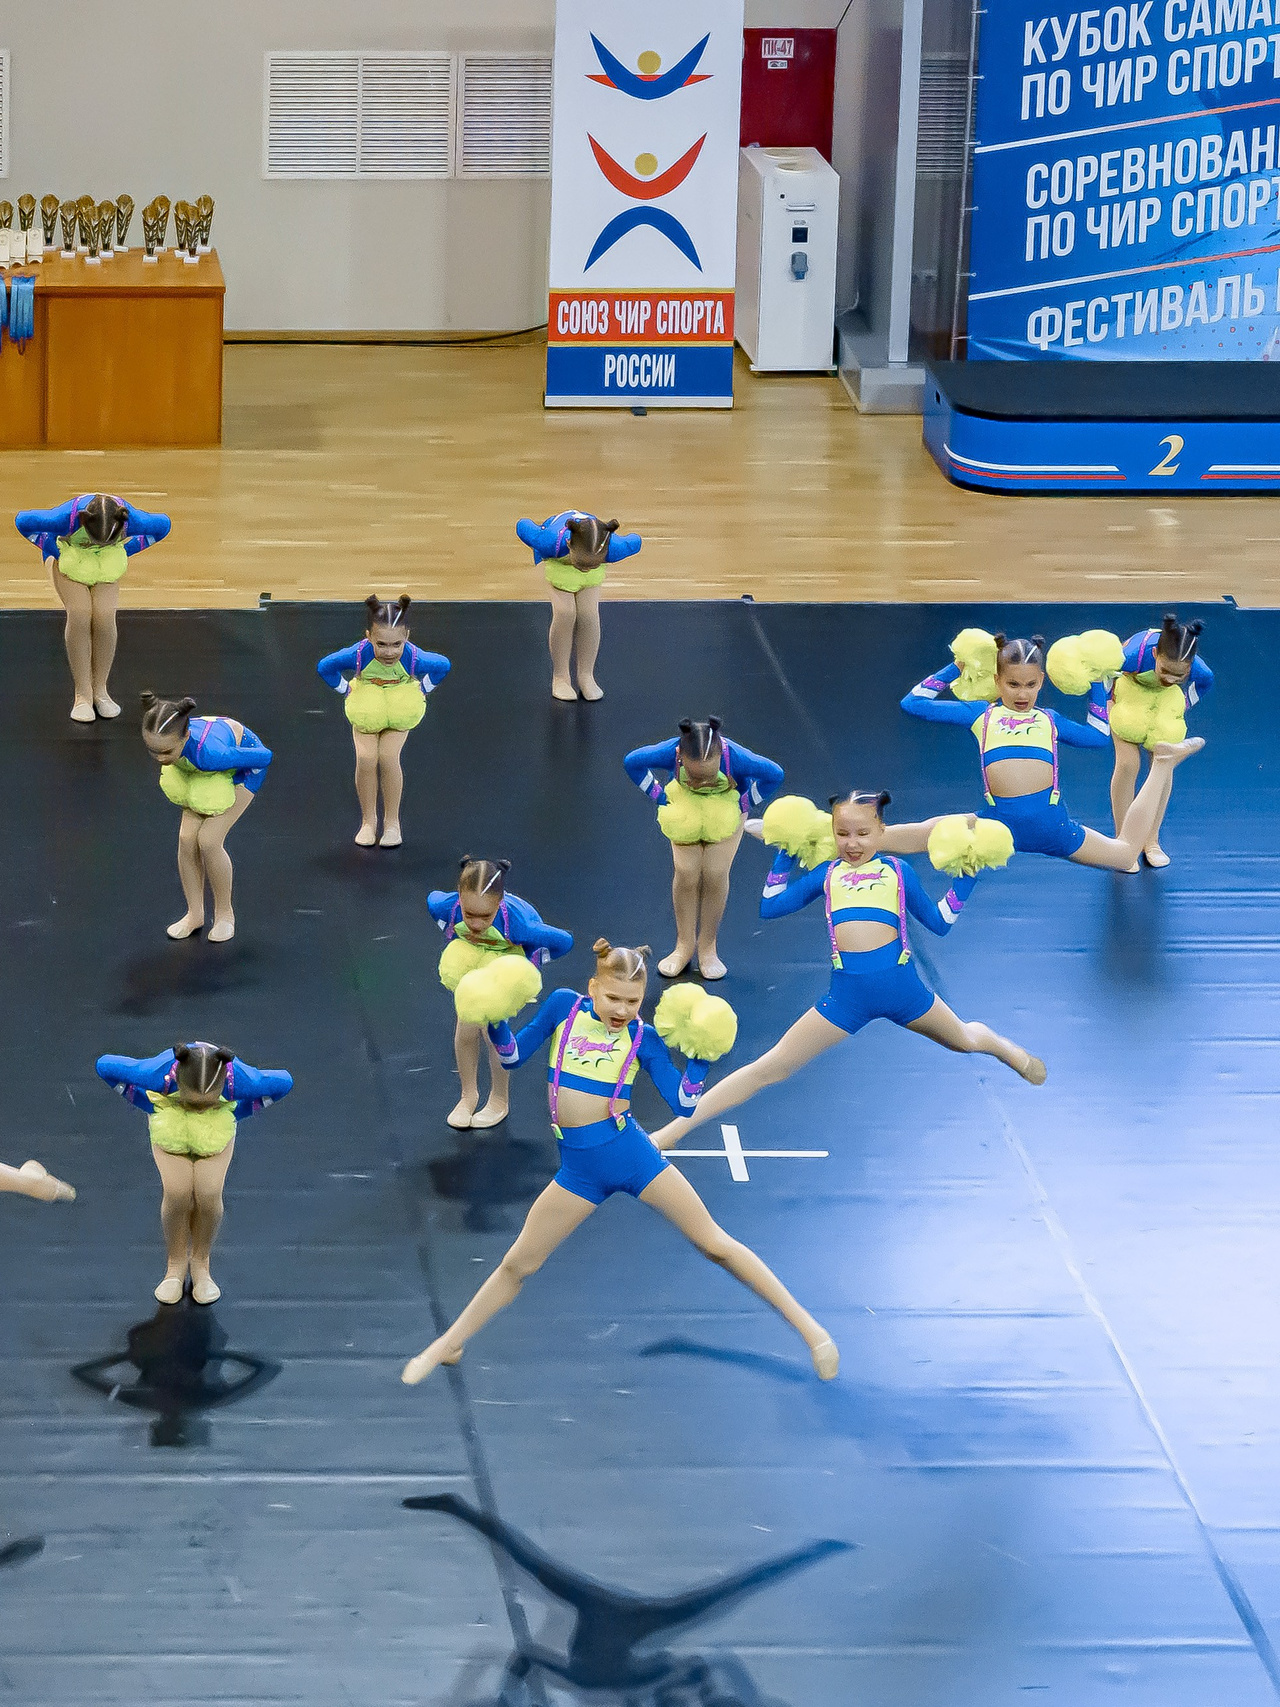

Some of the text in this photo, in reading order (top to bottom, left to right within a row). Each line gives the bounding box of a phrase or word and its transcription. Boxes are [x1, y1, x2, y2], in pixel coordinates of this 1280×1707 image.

[1023, 1, 1153, 66] КУБОК
[1021, 69, 1071, 120] ПО
[1082, 55, 1158, 109] ЧИР
[1026, 125, 1280, 209] СОРЕВНОВАН
[1025, 211, 1075, 262] ПО
[1086, 197, 1162, 249] ЧИР
[557, 300, 725, 335] СОЮЗ ЧИР СПОРТА
[1027, 273, 1265, 351] ФЕСТИВАЛЬ
[604, 354, 676, 388] РОССИИ
[1148, 434, 1185, 476] 2
